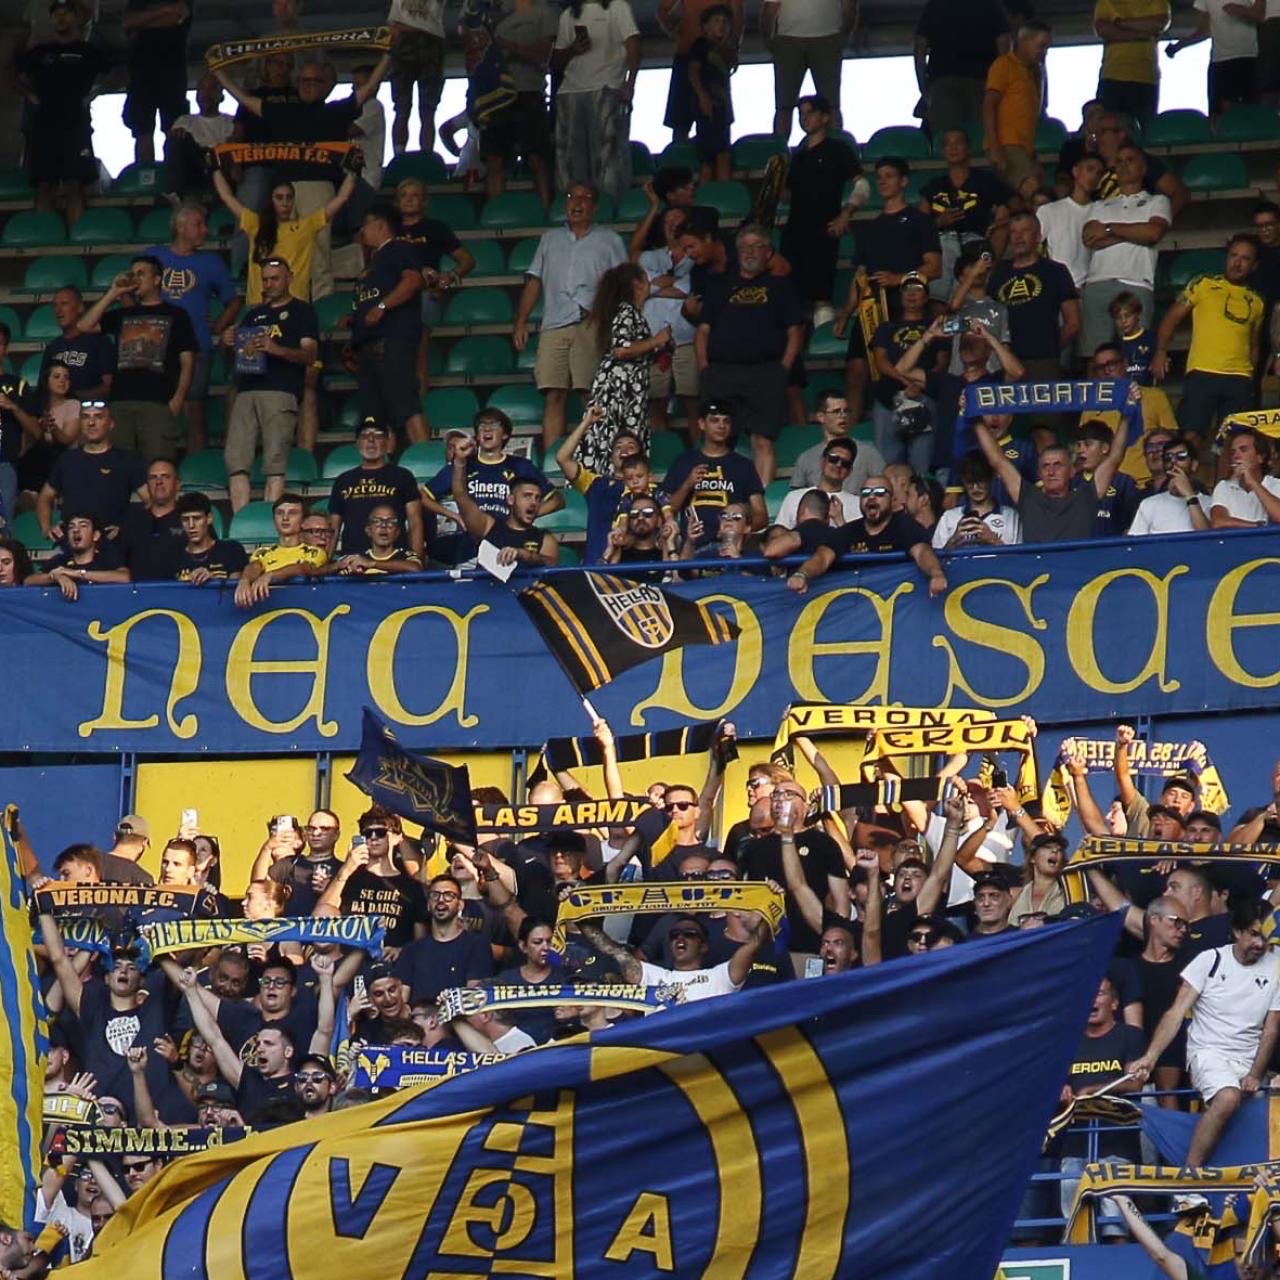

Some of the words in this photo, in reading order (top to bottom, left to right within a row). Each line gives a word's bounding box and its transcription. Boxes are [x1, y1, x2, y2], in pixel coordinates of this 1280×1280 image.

[233, 146, 300, 165] VERONA
[976, 383, 1116, 409] BRIGATE
[694, 479, 735, 493] ERONA
[603, 585, 663, 618] HELLAS
[791, 709, 983, 727] VERONA
[475, 806, 539, 828] LAS
[553, 802, 652, 827] ARMY
[51, 889, 138, 908] VERONA
[143, 891, 180, 909] F.C.
[296, 916, 378, 941] VERON
[401, 1049, 467, 1064] HELLAS
[1071, 1059, 1123, 1075] ERONA
[1086, 1161, 1223, 1184] HELLAS
